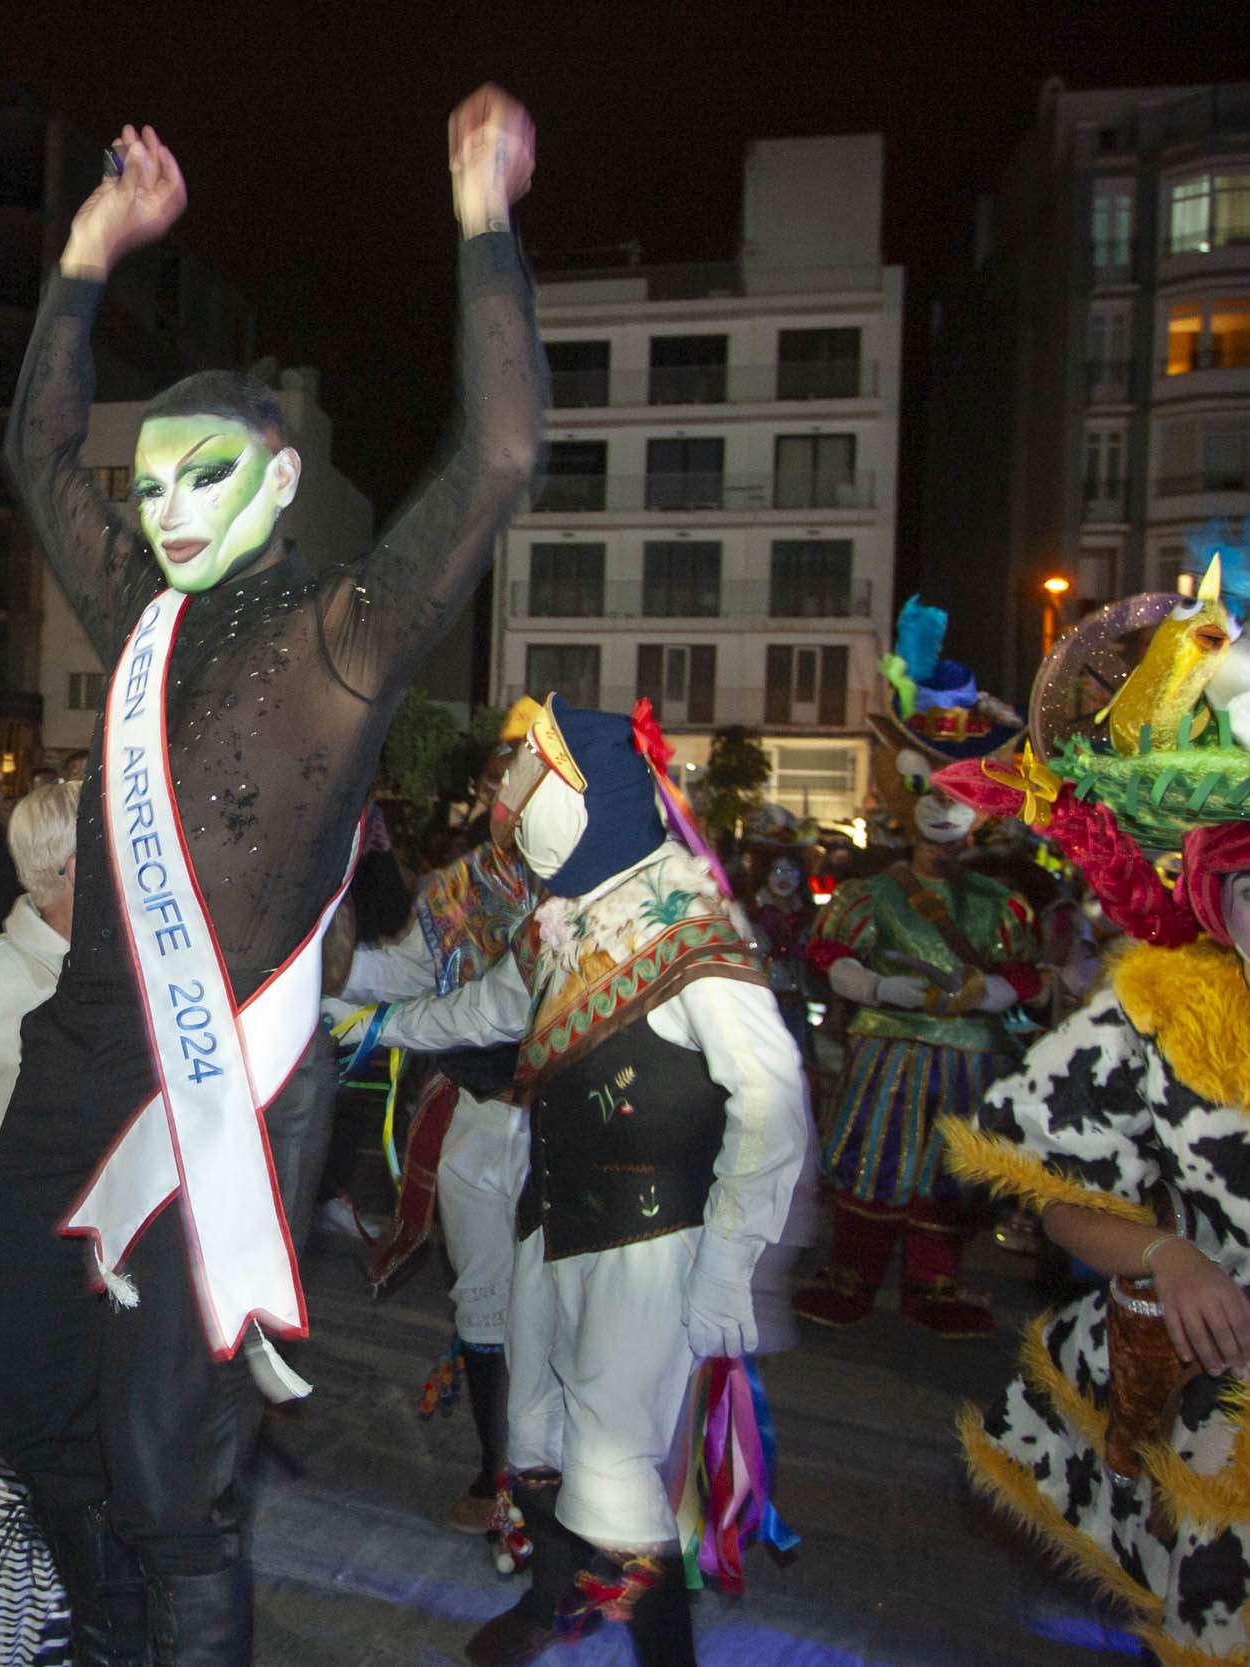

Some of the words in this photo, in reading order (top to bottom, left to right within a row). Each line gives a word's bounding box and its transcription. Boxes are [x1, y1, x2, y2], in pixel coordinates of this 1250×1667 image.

[124, 602, 161, 721] QUEEN
[123, 746, 192, 957] ARRECIFE
[169, 979, 224, 1084] 2024
